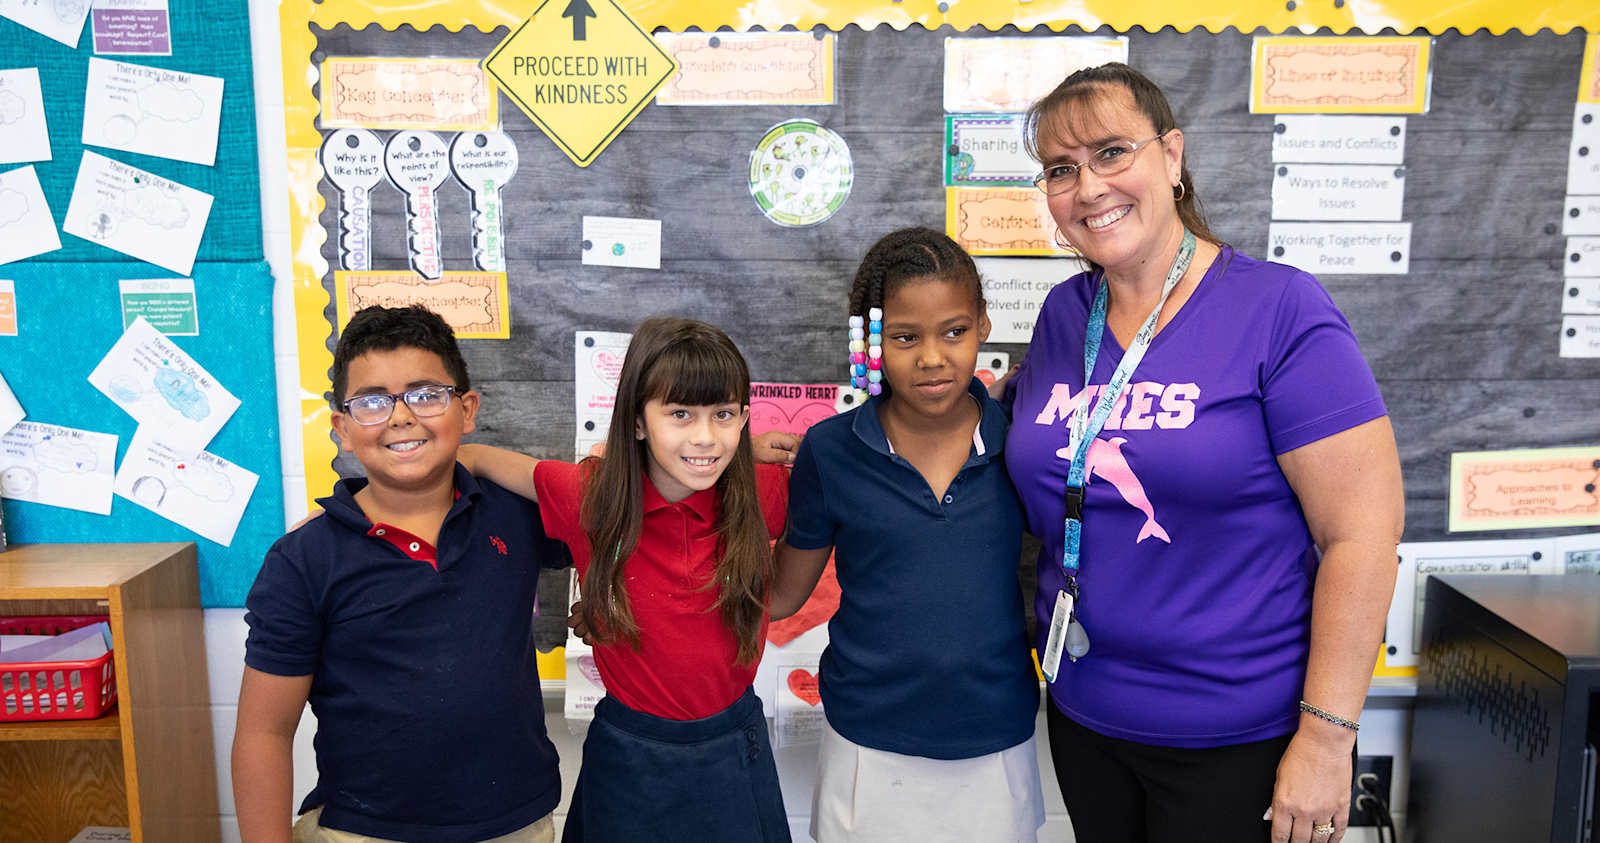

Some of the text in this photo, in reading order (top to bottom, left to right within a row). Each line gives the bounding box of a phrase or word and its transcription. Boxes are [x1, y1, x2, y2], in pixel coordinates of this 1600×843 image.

[513, 56, 648, 76] PROCEED WITH
[348, 88, 376, 105] Key
[535, 84, 628, 104] KINDNESS
[962, 138, 1020, 154] Sharing
[1278, 138, 1398, 150] Issues and Conflicts
[336, 153, 376, 164] Why is it
[392, 150, 414, 160] What
[432, 150, 446, 158] the
[462, 150, 483, 159] What
[484, 150, 491, 158] is
[334, 166, 379, 176] like this?
[401, 161, 439, 173] points of
[456, 160, 514, 170] responsibility?
[410, 174, 434, 183] view?
[1288, 177, 1390, 190] Ways to Resolve
[1319, 198, 1356, 209] Issues
[980, 215, 1042, 230] Central
[352, 186, 366, 272] CAUSATION
[1273, 234, 1403, 248] Working Together for
[1320, 255, 1356, 266] Peace
[986, 279, 1032, 291] Conflict
[986, 298, 1036, 310] olved in
[750, 384, 838, 400] WRINKLED HEART
[1101, 369, 1128, 412] Work hard
[15, 422, 38, 433] here's
[1496, 482, 1573, 496] Approaches to
[1511, 496, 1557, 506] Learning
